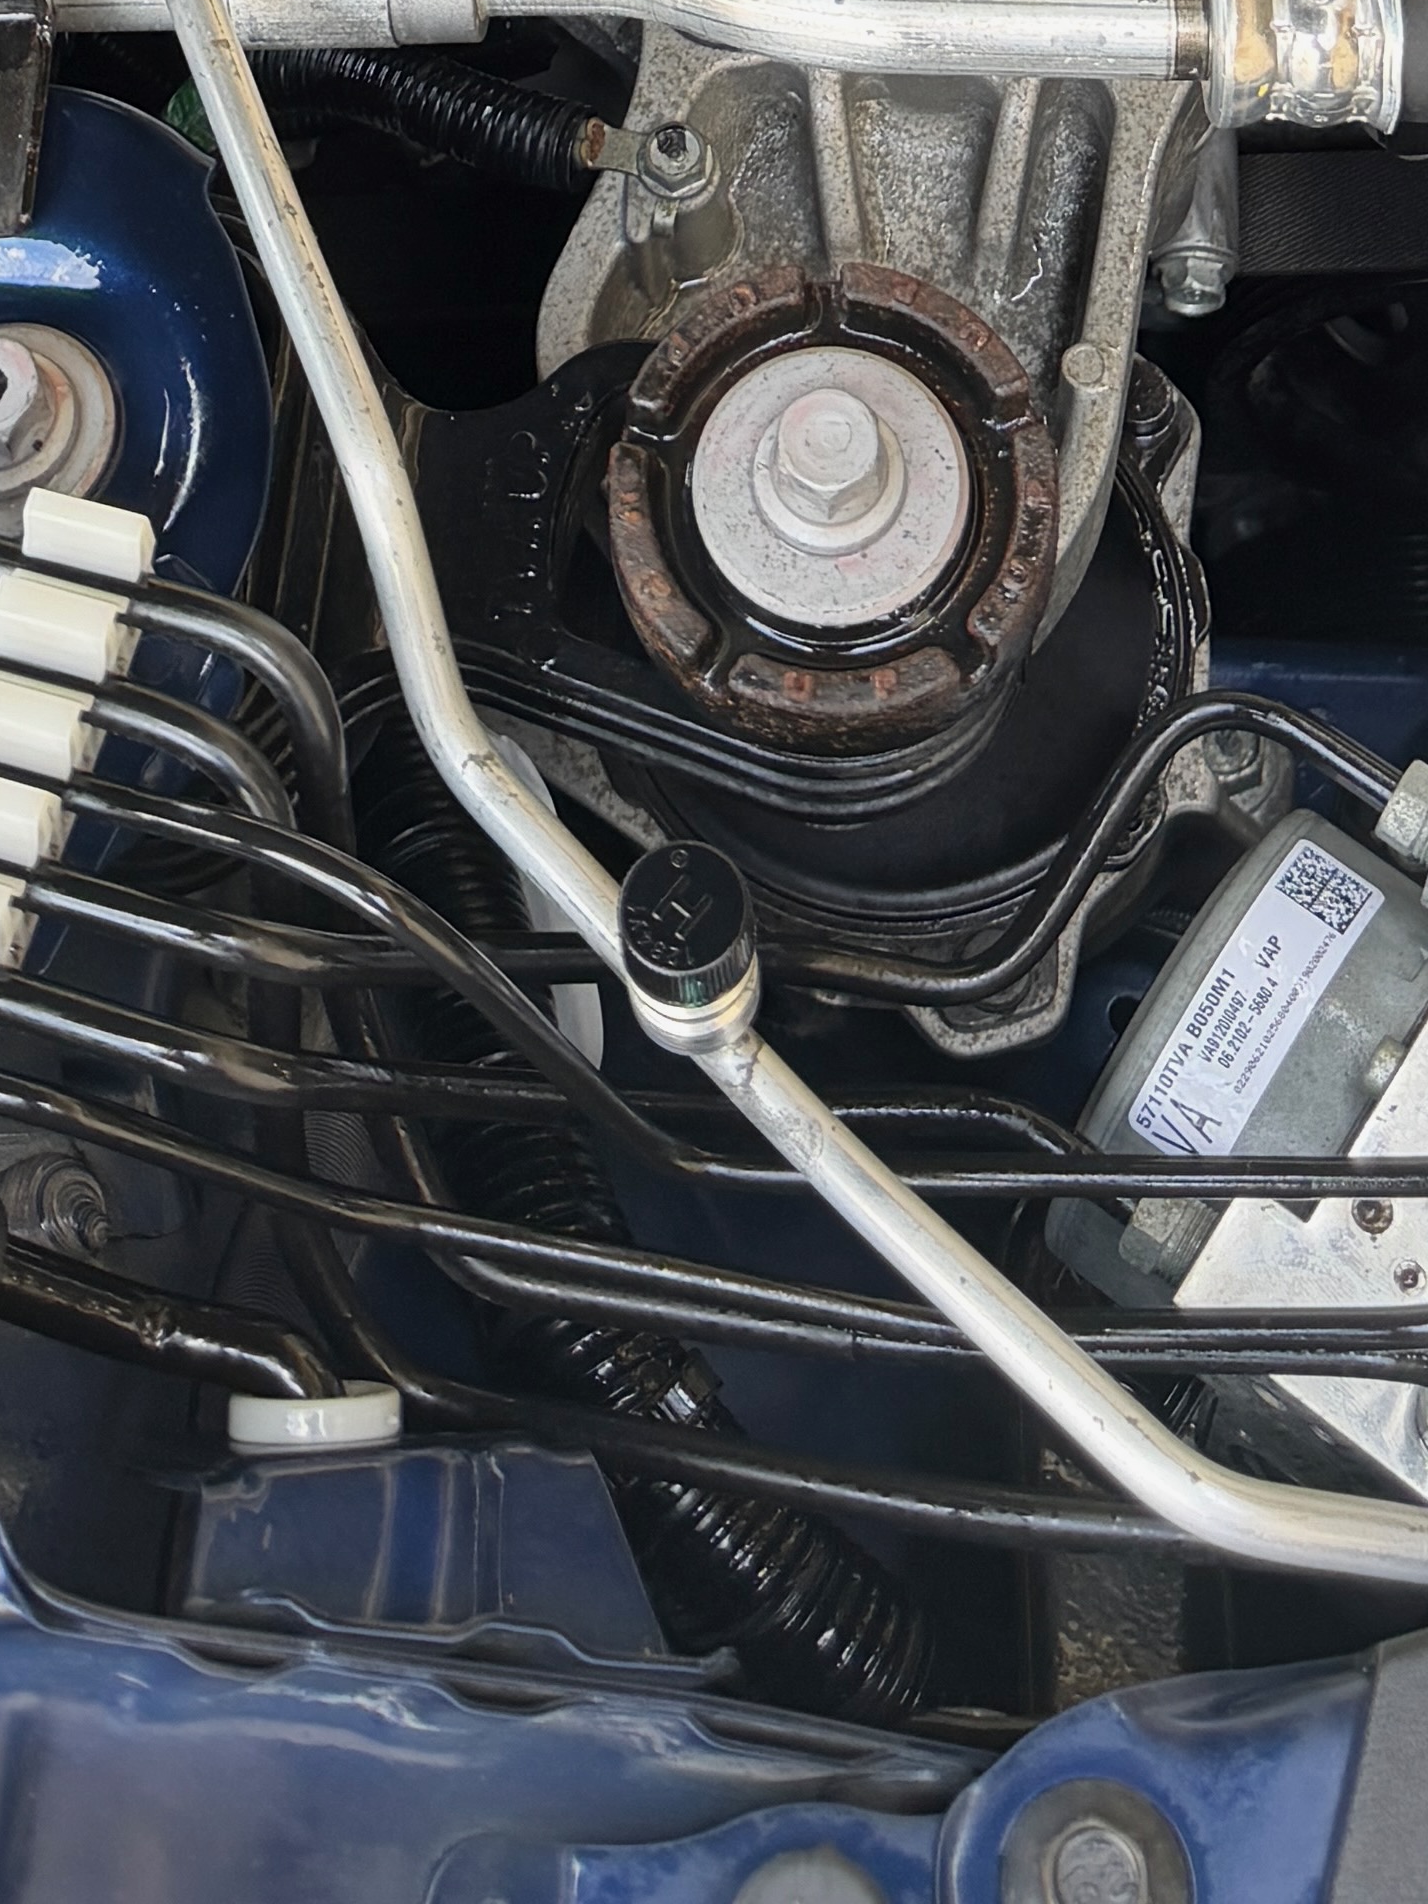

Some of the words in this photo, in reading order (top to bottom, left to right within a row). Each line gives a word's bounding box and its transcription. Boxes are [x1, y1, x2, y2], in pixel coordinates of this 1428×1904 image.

[1258, 933, 1284, 971] VAP
[1135, 1042, 1192, 1130] 57110TVA
[1184, 966, 1237, 1041] B050M1
[1151, 1093, 1223, 1158] VA
